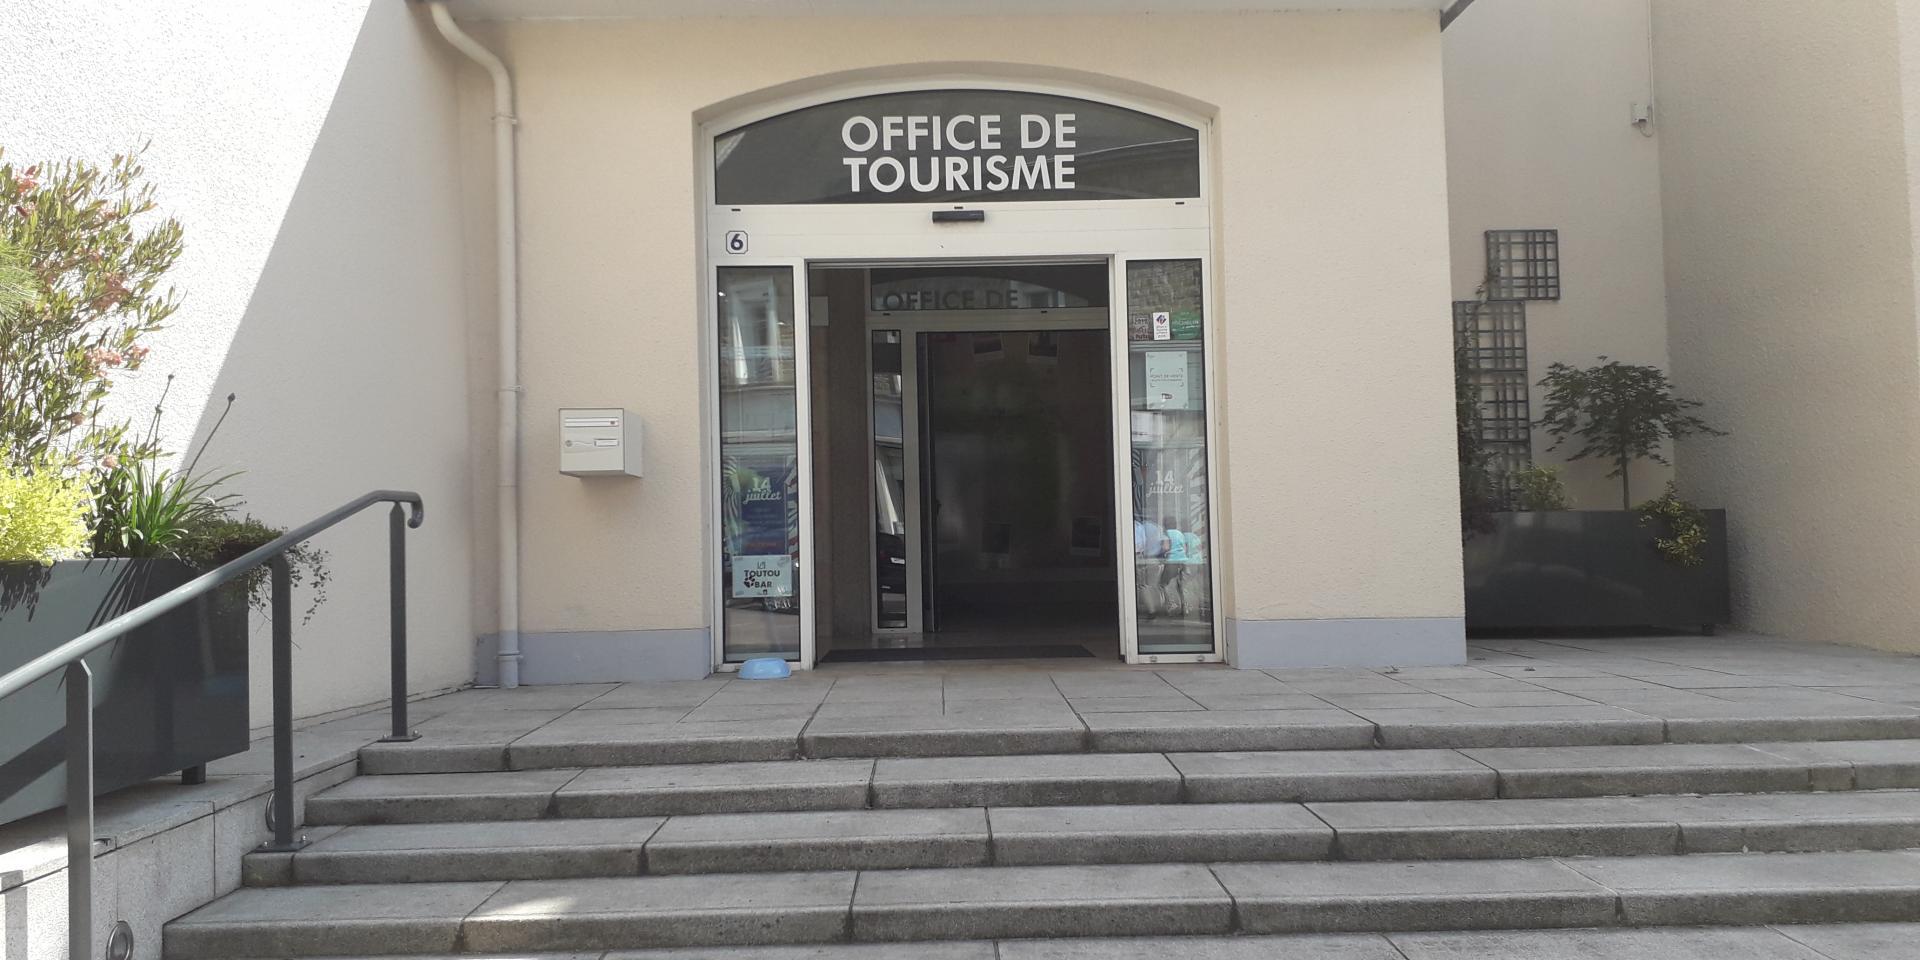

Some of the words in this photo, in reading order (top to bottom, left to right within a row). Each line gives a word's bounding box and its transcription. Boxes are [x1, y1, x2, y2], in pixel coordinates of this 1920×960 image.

[841, 114, 1001, 152] OFFICE
[1020, 113, 1076, 149] DE
[843, 154, 1076, 193] TOURISME
[731, 233, 744, 251] 6
[884, 290, 975, 309] OFFICE
[987, 289, 1018, 309] DE
[752, 477, 771, 492] 14
[1156, 470, 1174, 484] 14
[744, 569, 781, 577] TOUTOU
